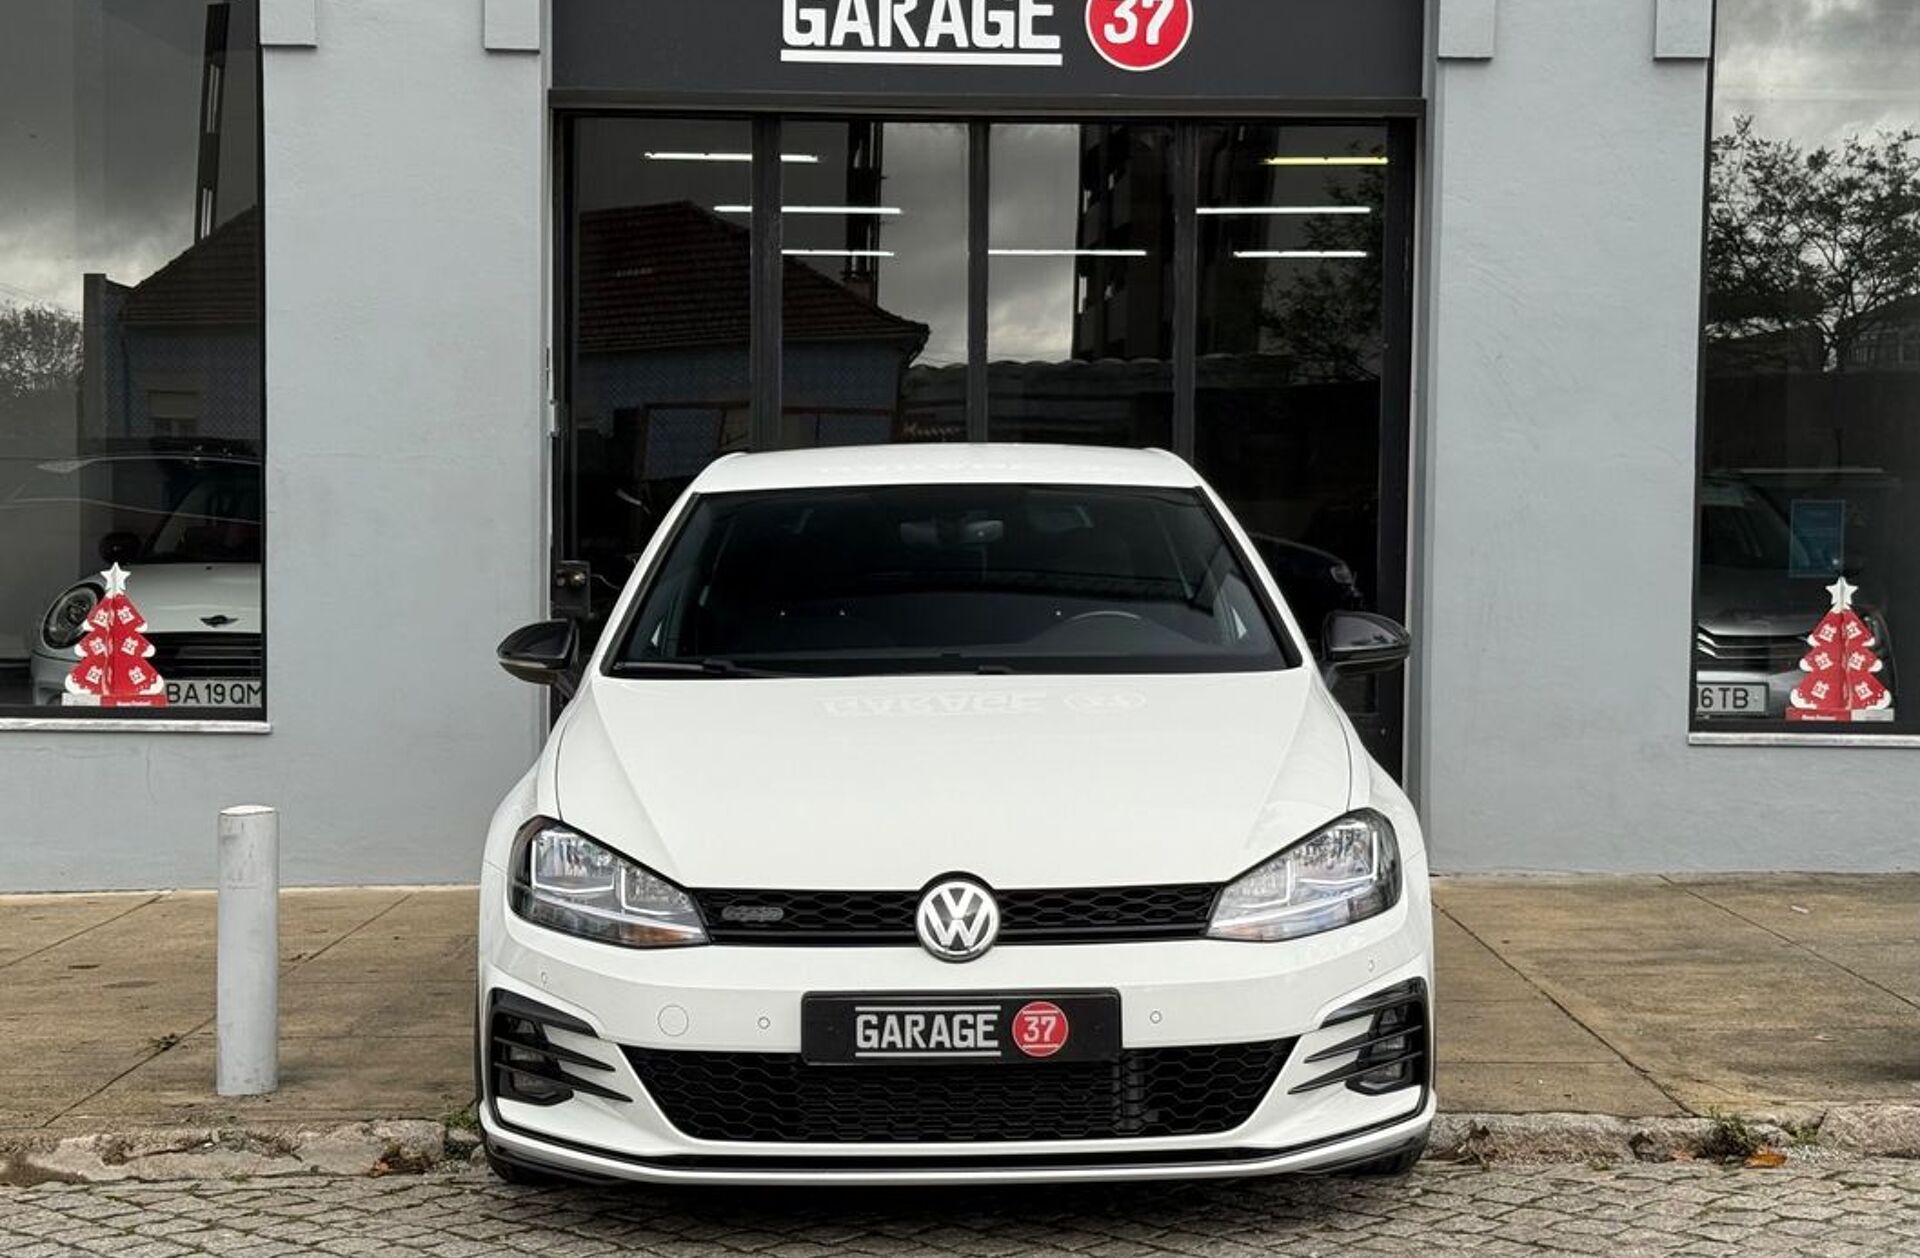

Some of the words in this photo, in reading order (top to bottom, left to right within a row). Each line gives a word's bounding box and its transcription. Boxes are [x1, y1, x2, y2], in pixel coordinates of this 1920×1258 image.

[782, 0, 1062, 49] GARAGE
[1103, 0, 1175, 45] 37
[166, 683, 200, 704] BA
[205, 683, 226, 704] 19
[1718, 687, 1749, 709] TB
[855, 1013, 999, 1049] GARAGE
[1022, 1015, 1058, 1043] 37
